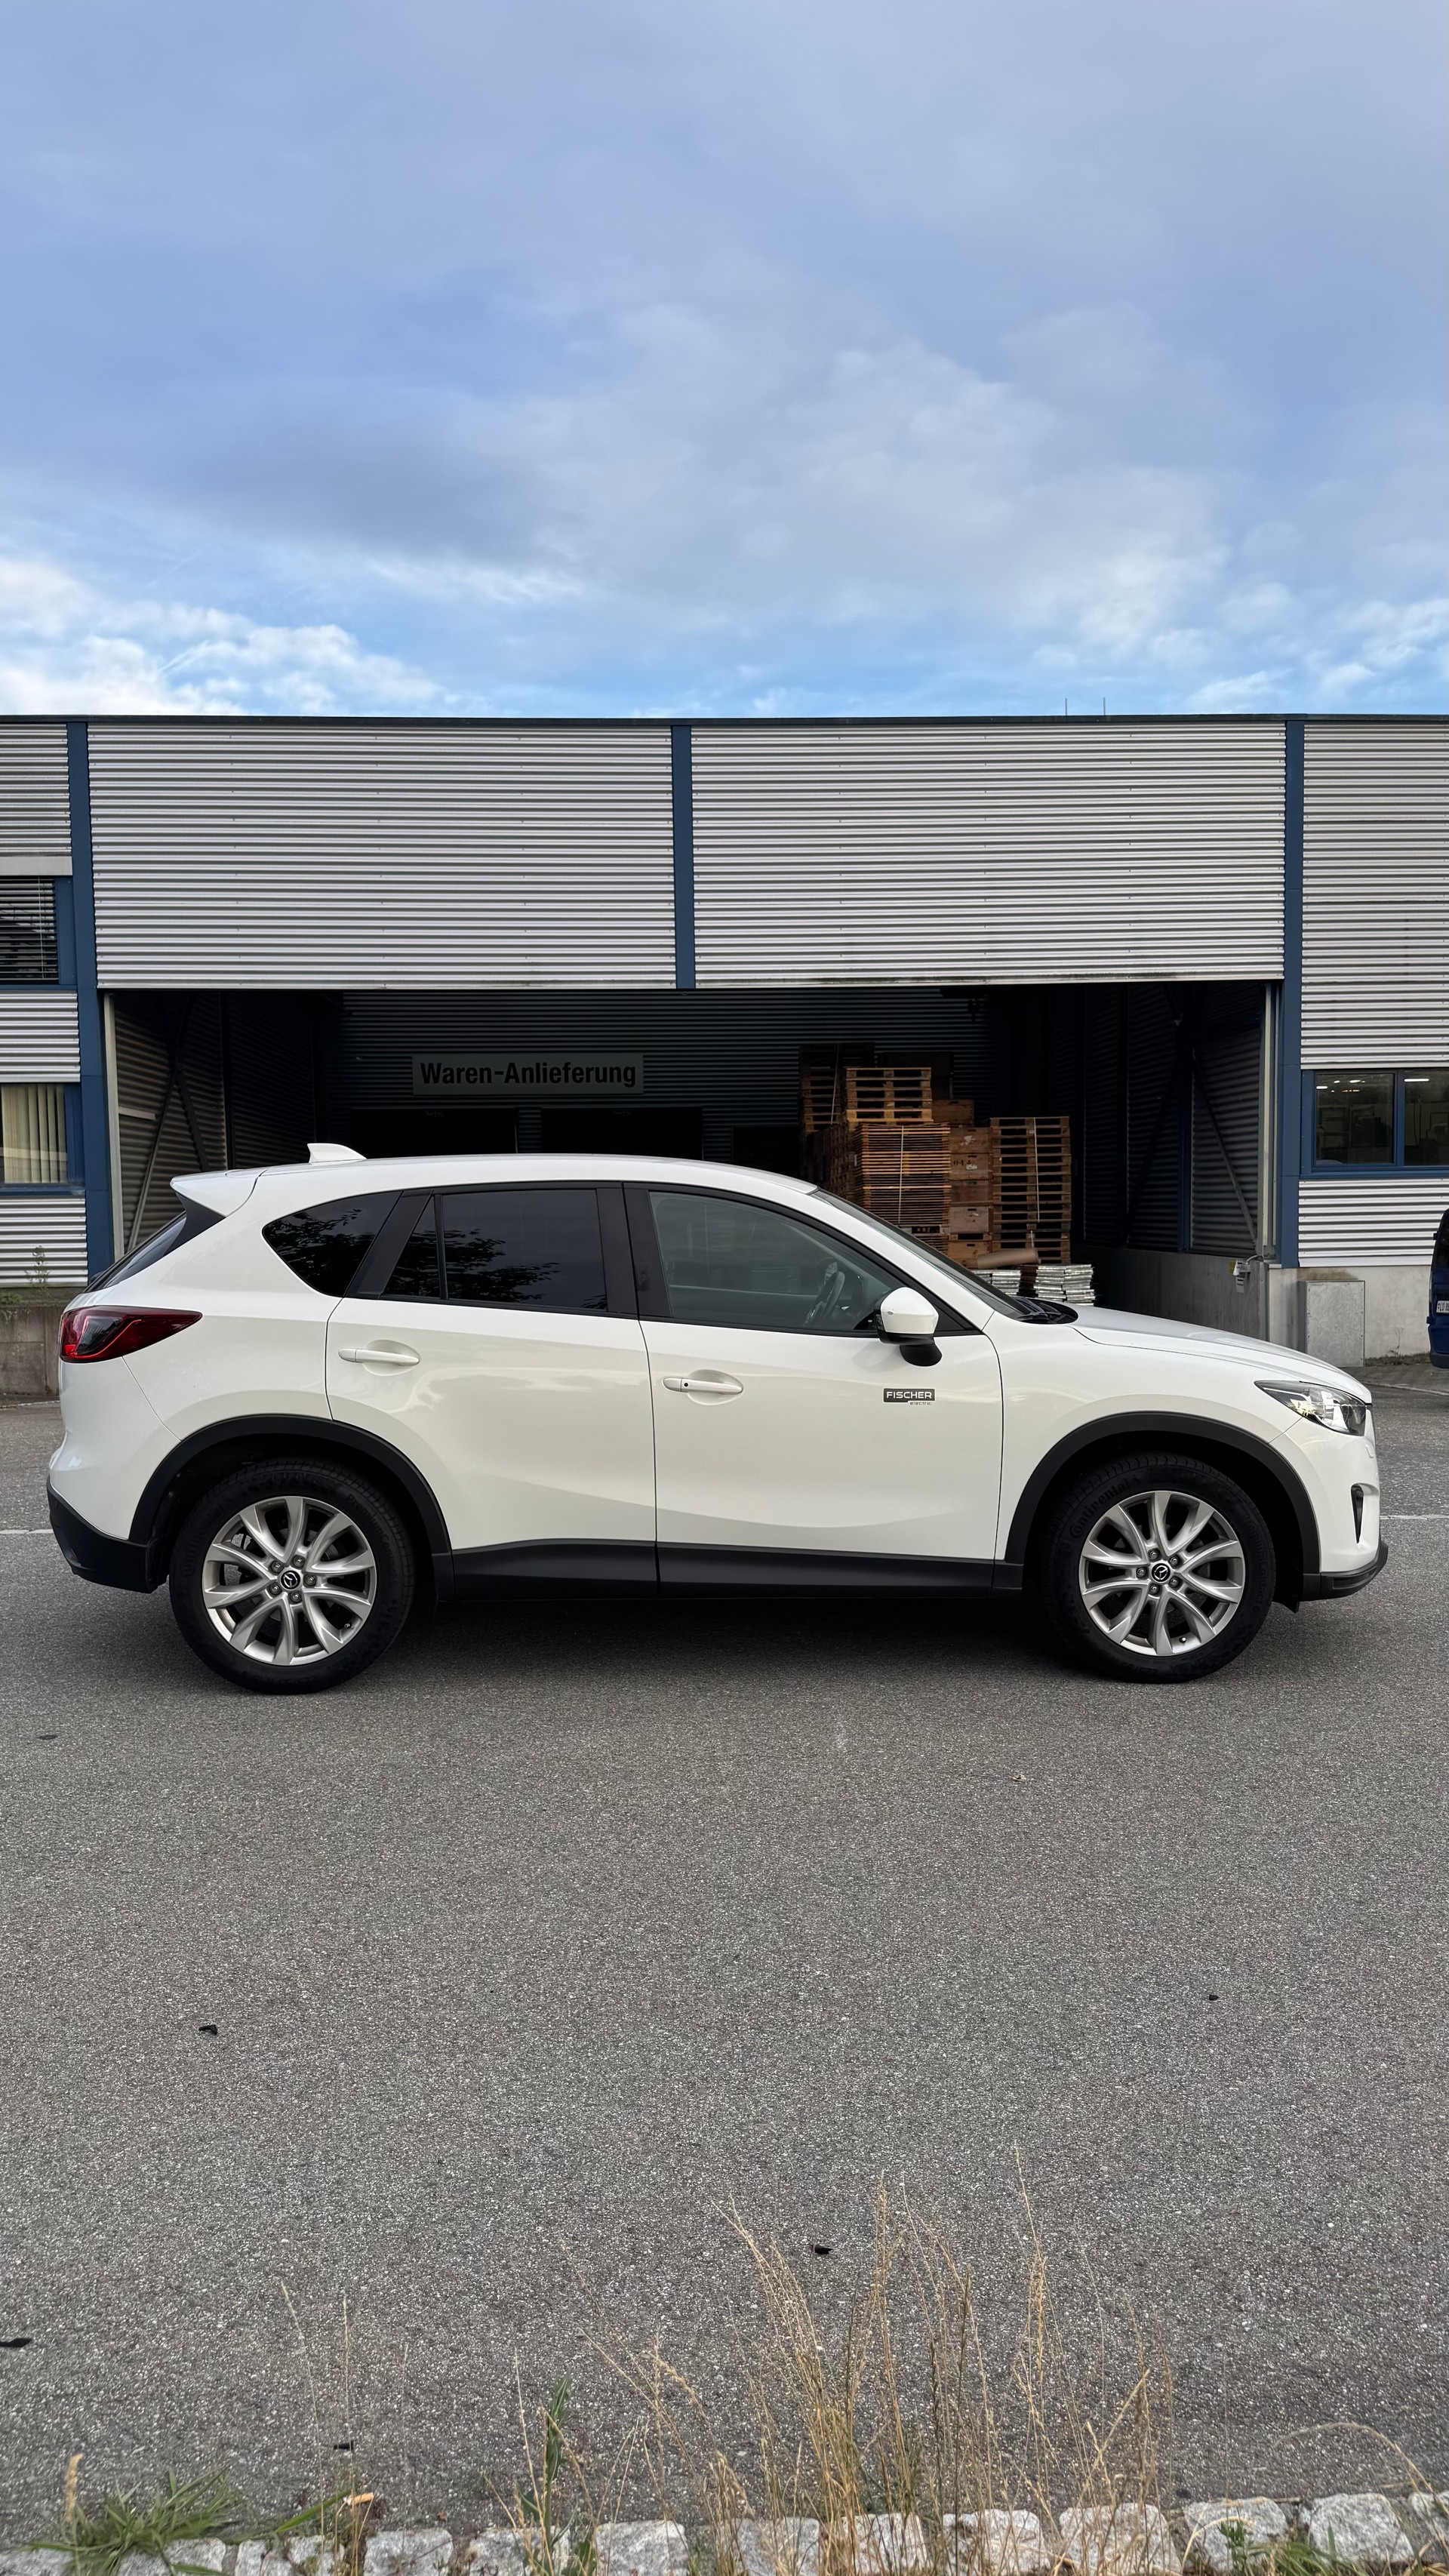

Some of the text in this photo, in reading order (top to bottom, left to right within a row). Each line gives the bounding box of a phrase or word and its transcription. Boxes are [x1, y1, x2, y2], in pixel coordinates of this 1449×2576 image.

[420, 1062, 636, 1088] Waren-Anlieferung
[886, 1391, 932, 1399] FISCHER
[1069, 1479, 1131, 1539] Continental
[346, 1492, 397, 1578] PremiumContact
